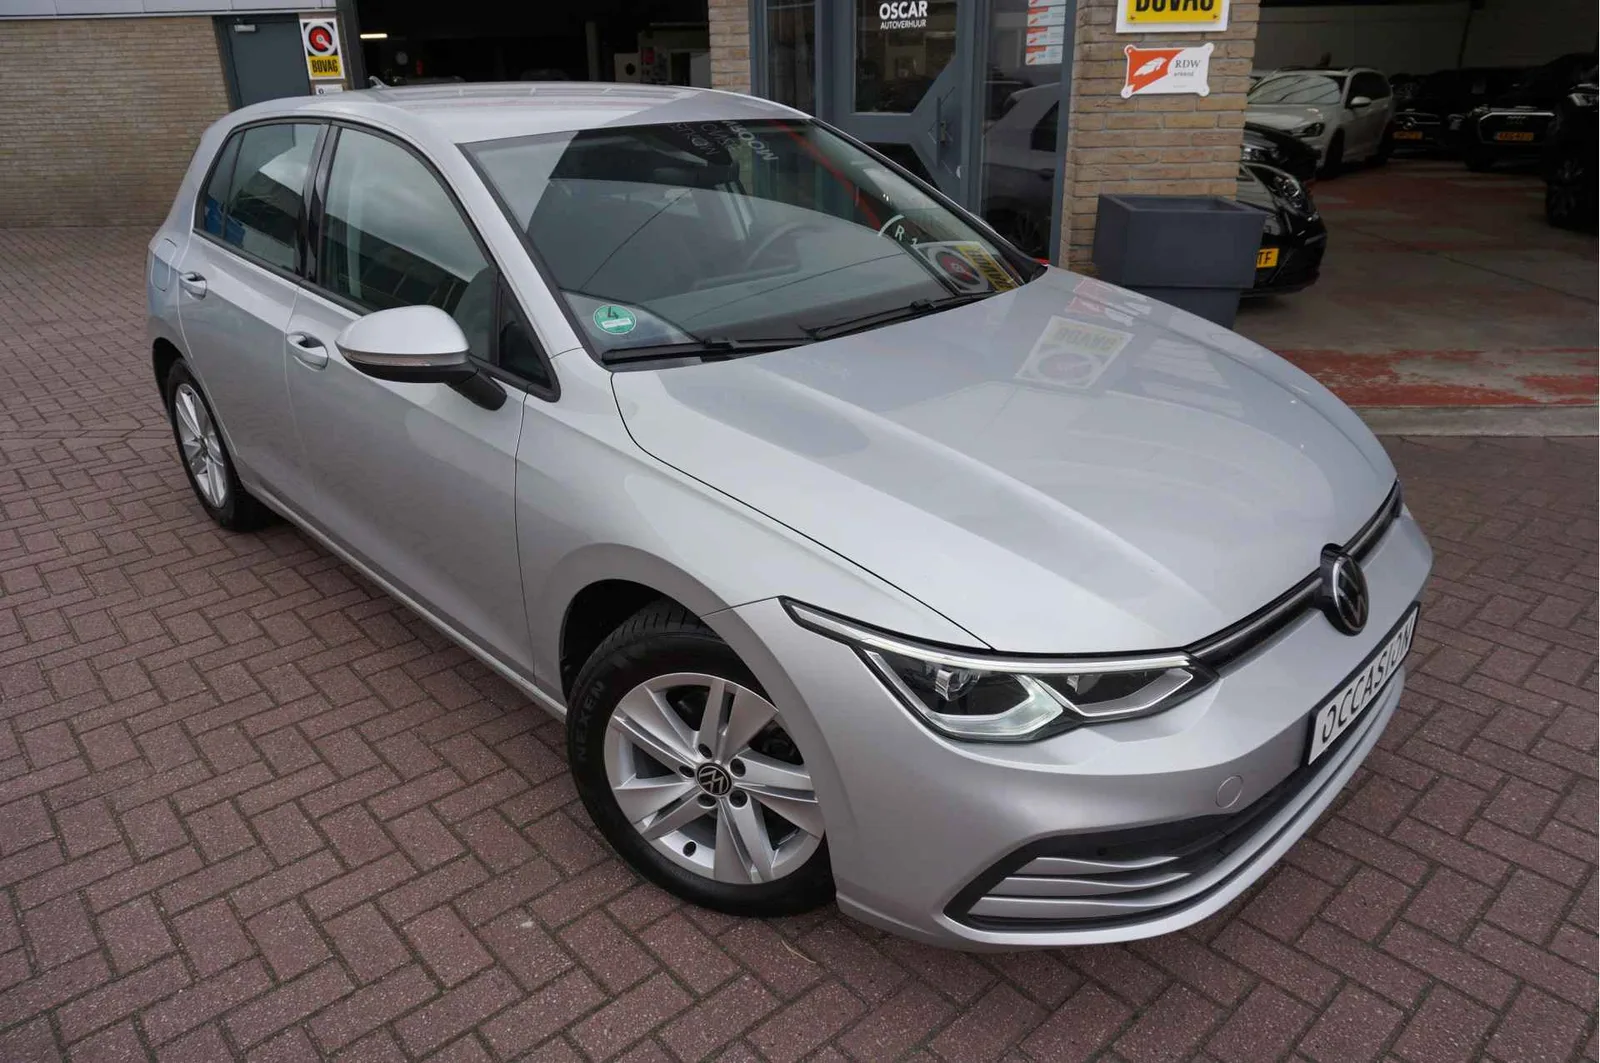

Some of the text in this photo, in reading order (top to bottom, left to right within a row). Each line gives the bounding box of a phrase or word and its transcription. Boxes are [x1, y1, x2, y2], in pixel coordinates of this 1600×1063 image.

[879, 1, 928, 20] OSCAR
[880, 20, 927, 30] AUTOVERHUUR
[311, 59, 338, 73] BOVAG
[1174, 59, 1201, 69] RDW
[1321, 616, 1415, 744] OCCASION
[575, 680, 606, 762] NEXEN
